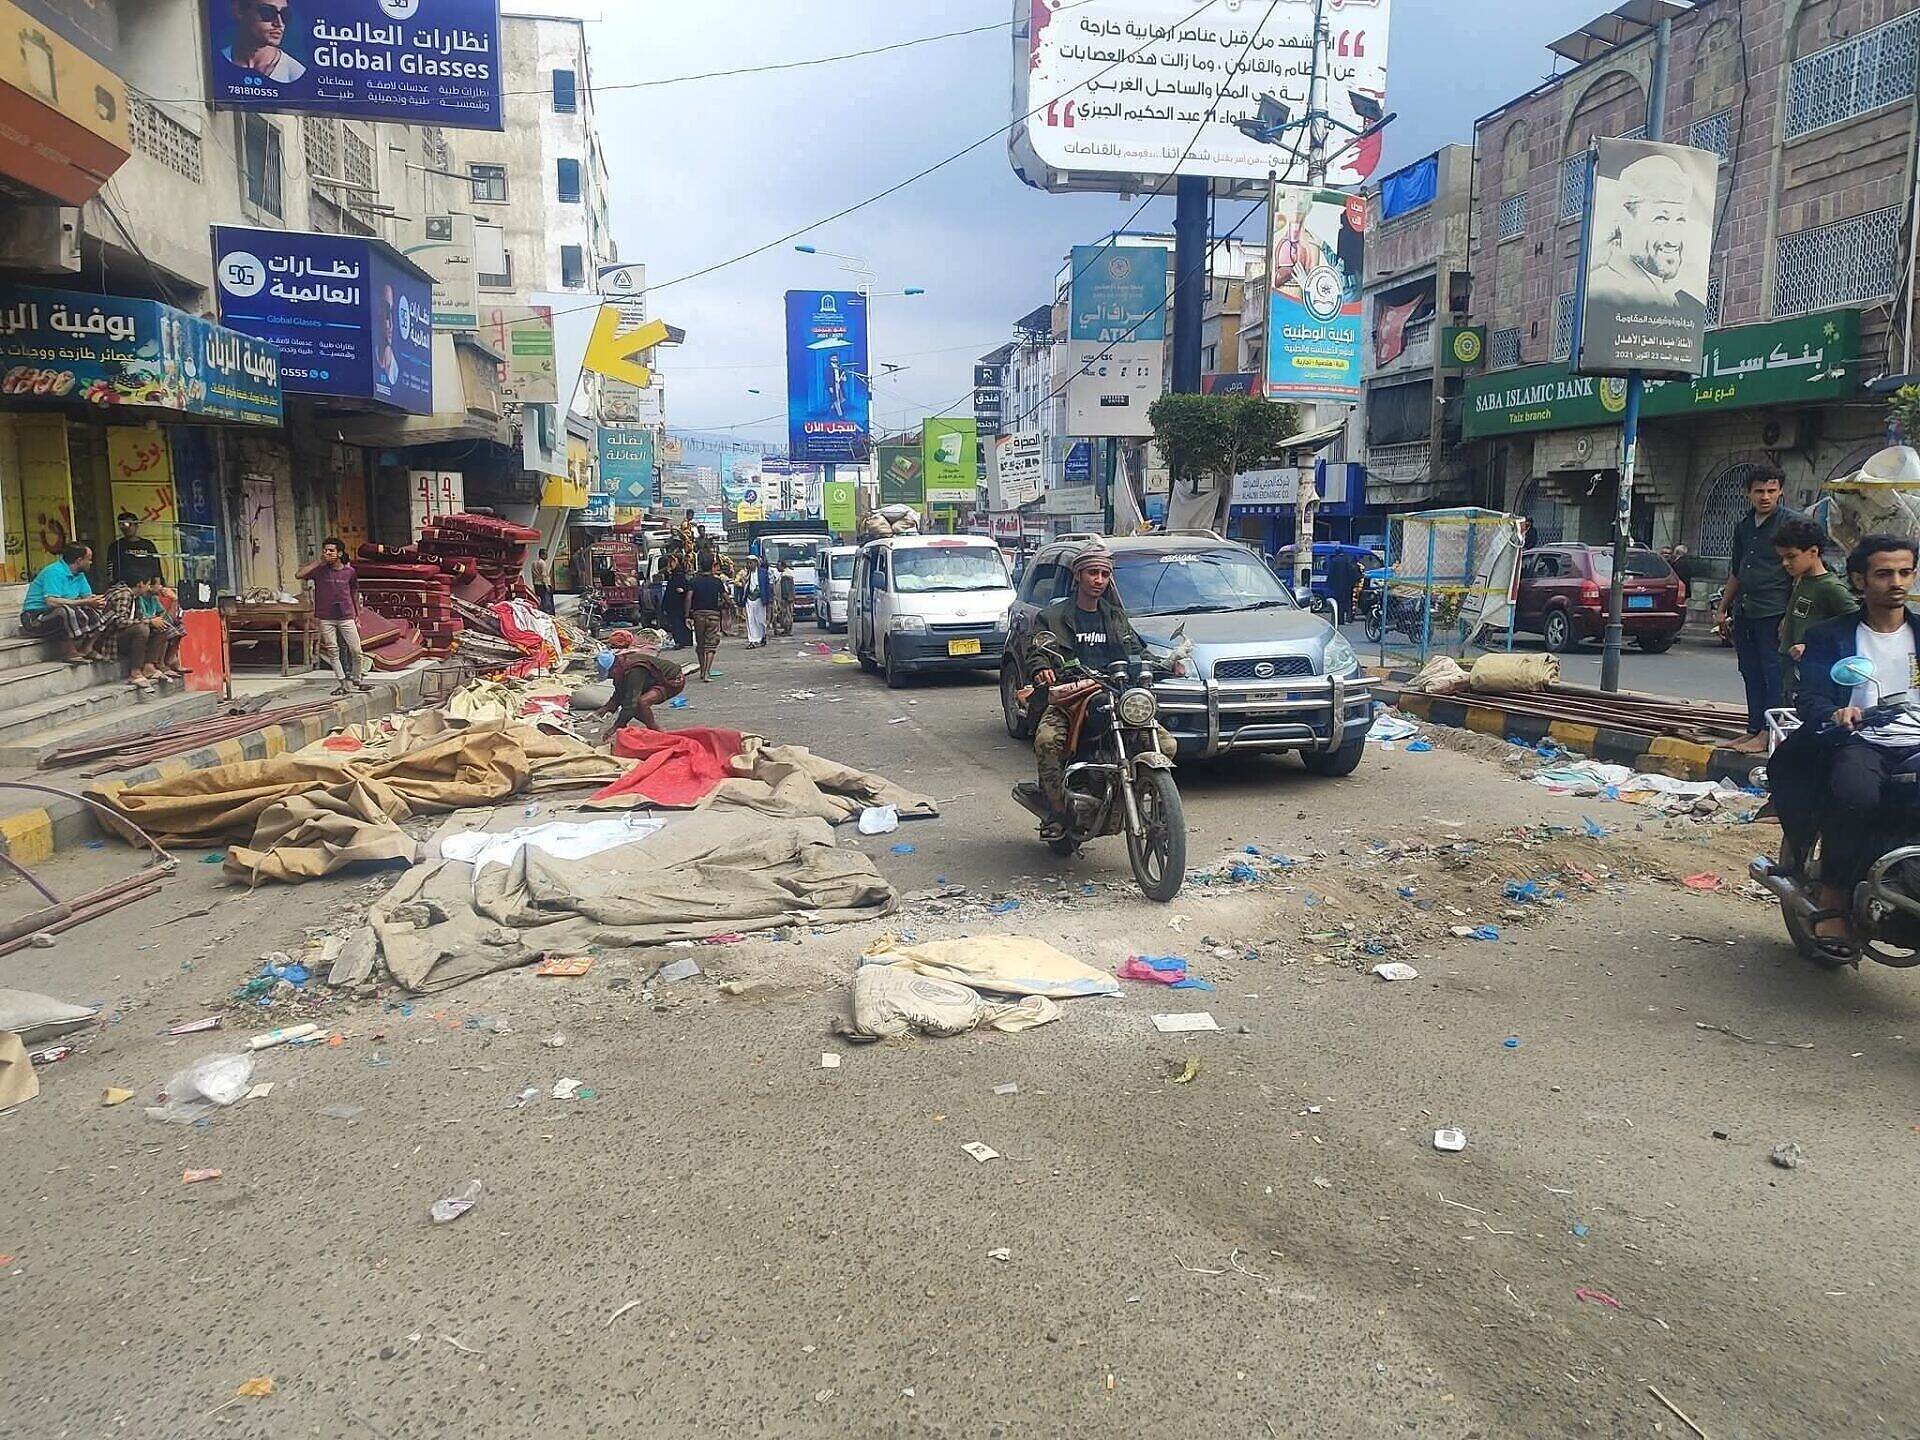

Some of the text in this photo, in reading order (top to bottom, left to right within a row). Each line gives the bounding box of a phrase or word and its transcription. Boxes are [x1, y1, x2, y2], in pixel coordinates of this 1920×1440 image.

[1080, 16, 1121, 37] خارجة
[1177, 26, 1217, 43] عناصر
[313, 19, 489, 54] نظارات العالمية
[1219, 30, 1249, 48] قبل
[1253, 34, 1275, 50] من
[1060, 44, 1125, 63] العصابات
[313, 46, 489, 80] Global Glasses
[1225, 59, 1282, 77] والقانون
[1334, 63, 1356, 81] عن
[1087, 76, 1142, 95] الغربي
[1146, 77, 1213, 98] والساحل
[1124, 104, 1174, 122] الحكيم
[1176, 112, 1200, 125] عبد
[268, 254, 360, 279] نظارات
[269, 278, 360, 305] العالمية
[49, 303, 136, 342] بوفية
[1097, 327, 1136, 342] ATM
[1282, 324, 1354, 344] الكلية الوطنية
[59, 347, 96, 362] طازجة
[99, 346, 136, 364] عصائر
[206, 331, 277, 387] بوفية الريان
[1766, 342, 1824, 370] بنك
[975, 392, 1000, 405] فندق
[1475, 376, 1594, 413] SABA ISLAMIC BANK
[1525, 408, 1552, 422] branch
[826, 422, 857, 434] سجل
